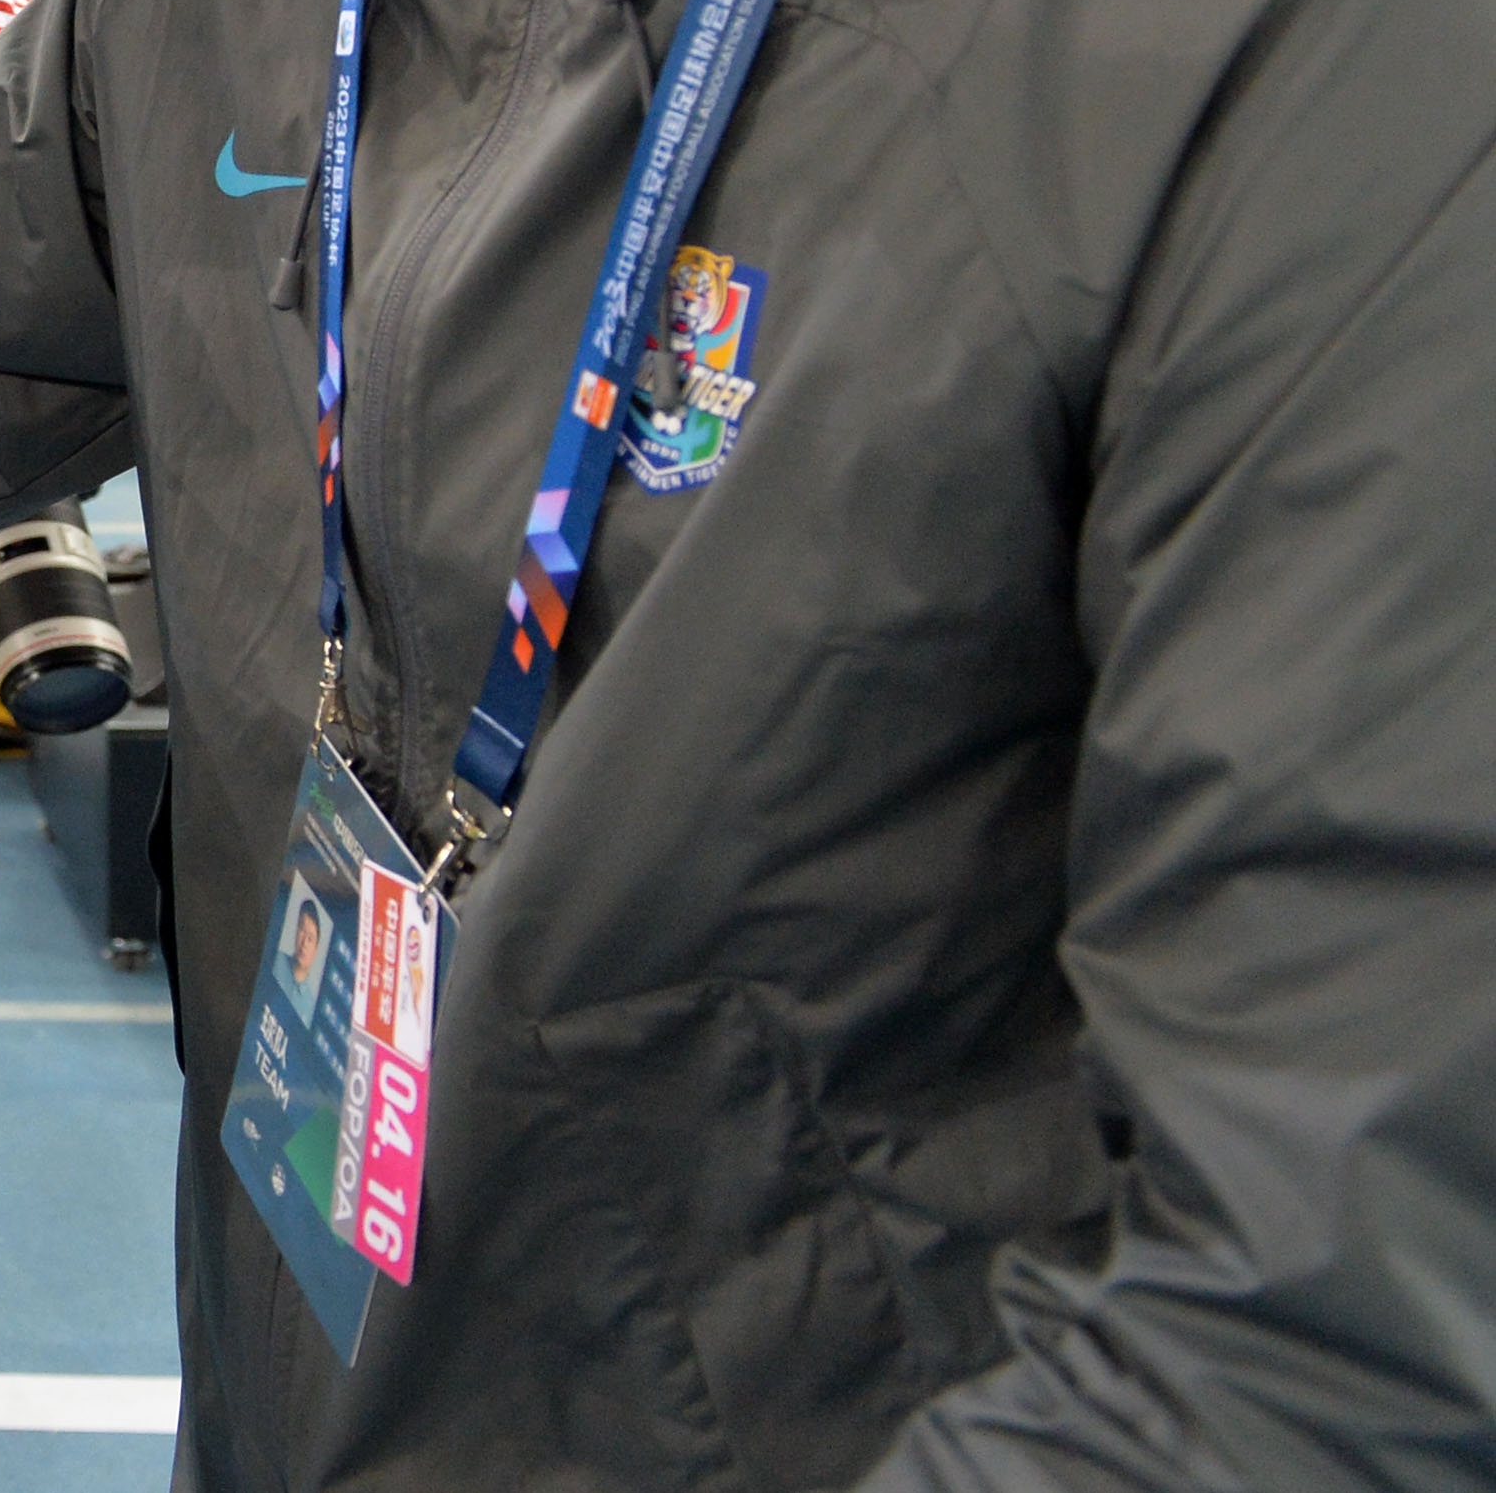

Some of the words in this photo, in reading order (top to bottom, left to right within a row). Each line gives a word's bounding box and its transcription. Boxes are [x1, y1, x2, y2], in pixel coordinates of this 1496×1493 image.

[665, 120, 707, 198] FOOTBALL
[698, 17, 748, 117] ASSOCIATION
[683, 364, 756, 421] TIGER
[377, 897, 399, 1025] 中国平安
[255, 1039, 291, 1112] TEAM
[334, 1040, 373, 1222] FOP/OA
